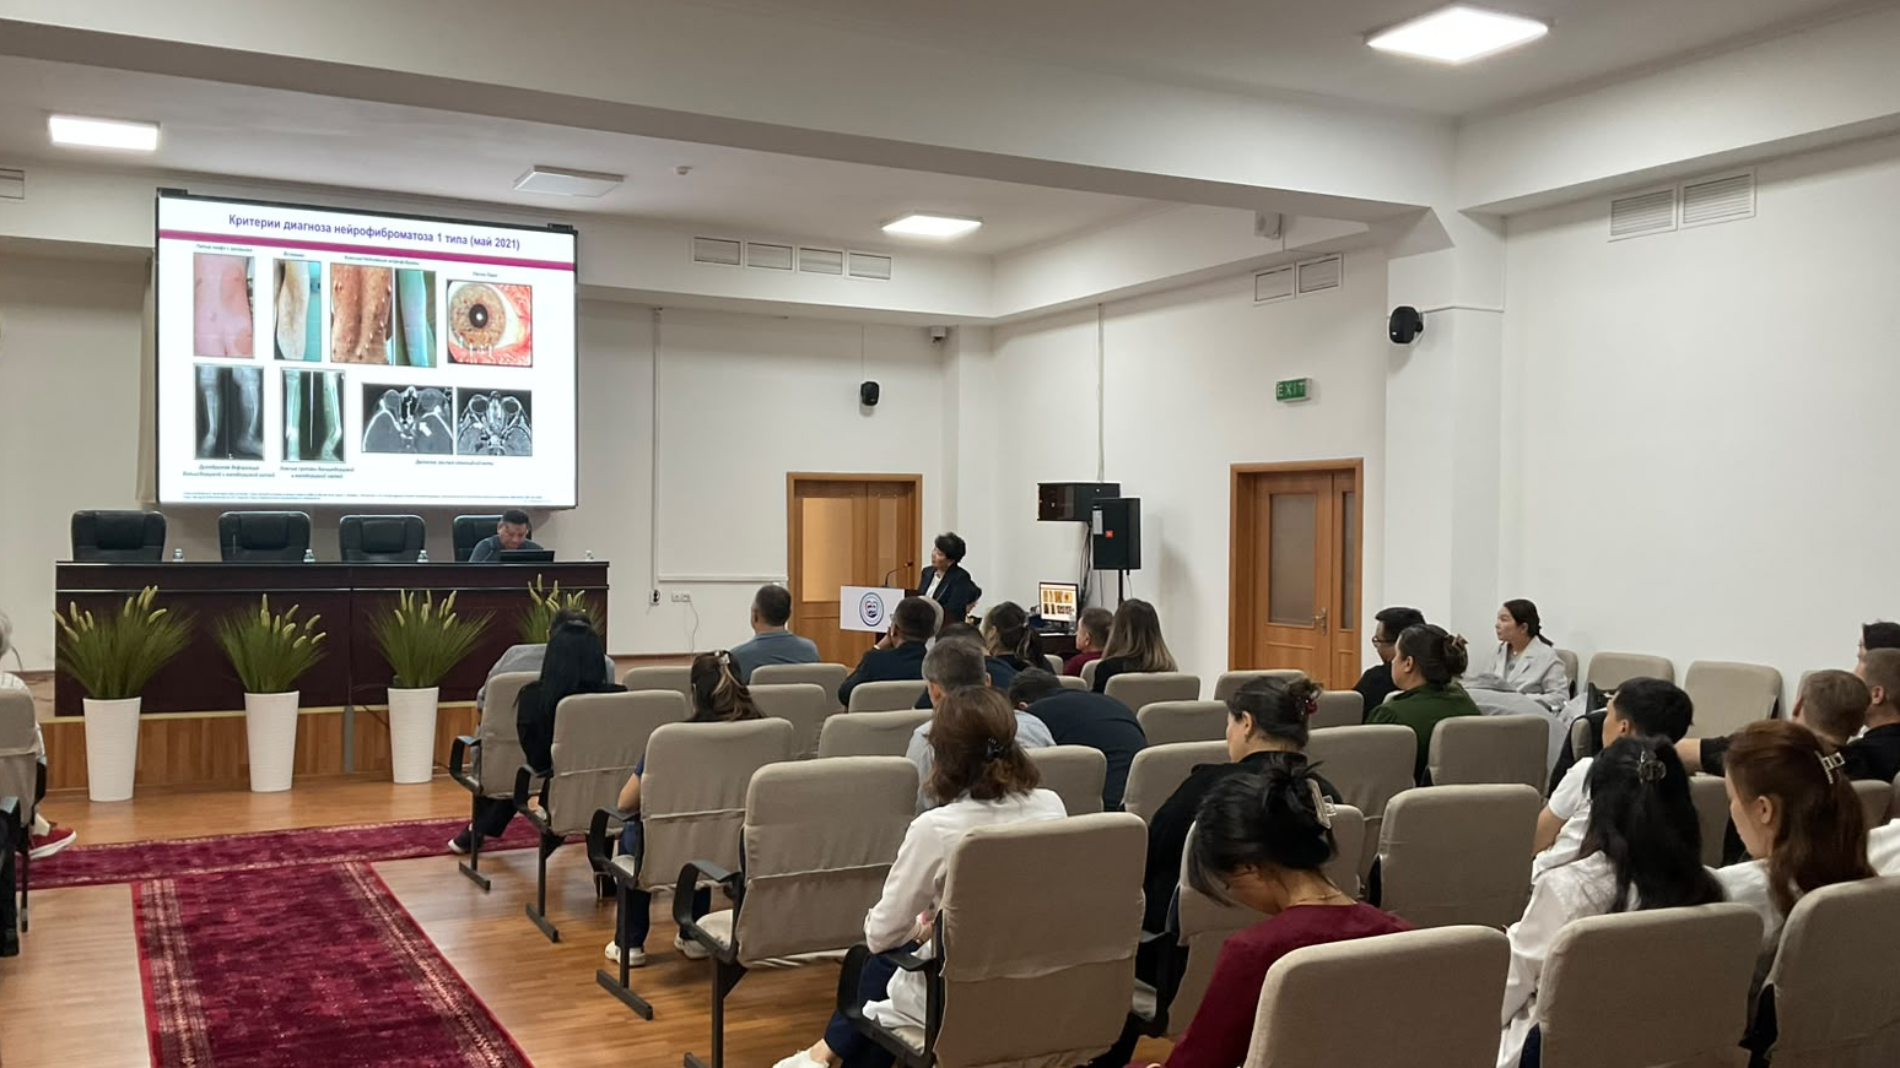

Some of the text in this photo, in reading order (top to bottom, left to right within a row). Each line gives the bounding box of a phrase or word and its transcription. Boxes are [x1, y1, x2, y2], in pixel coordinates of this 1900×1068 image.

[228, 213, 520, 250] Критерии диагноза нейрофиброматоза 1 типа (май 2021)
[1277, 381, 1305, 397] EXIT
